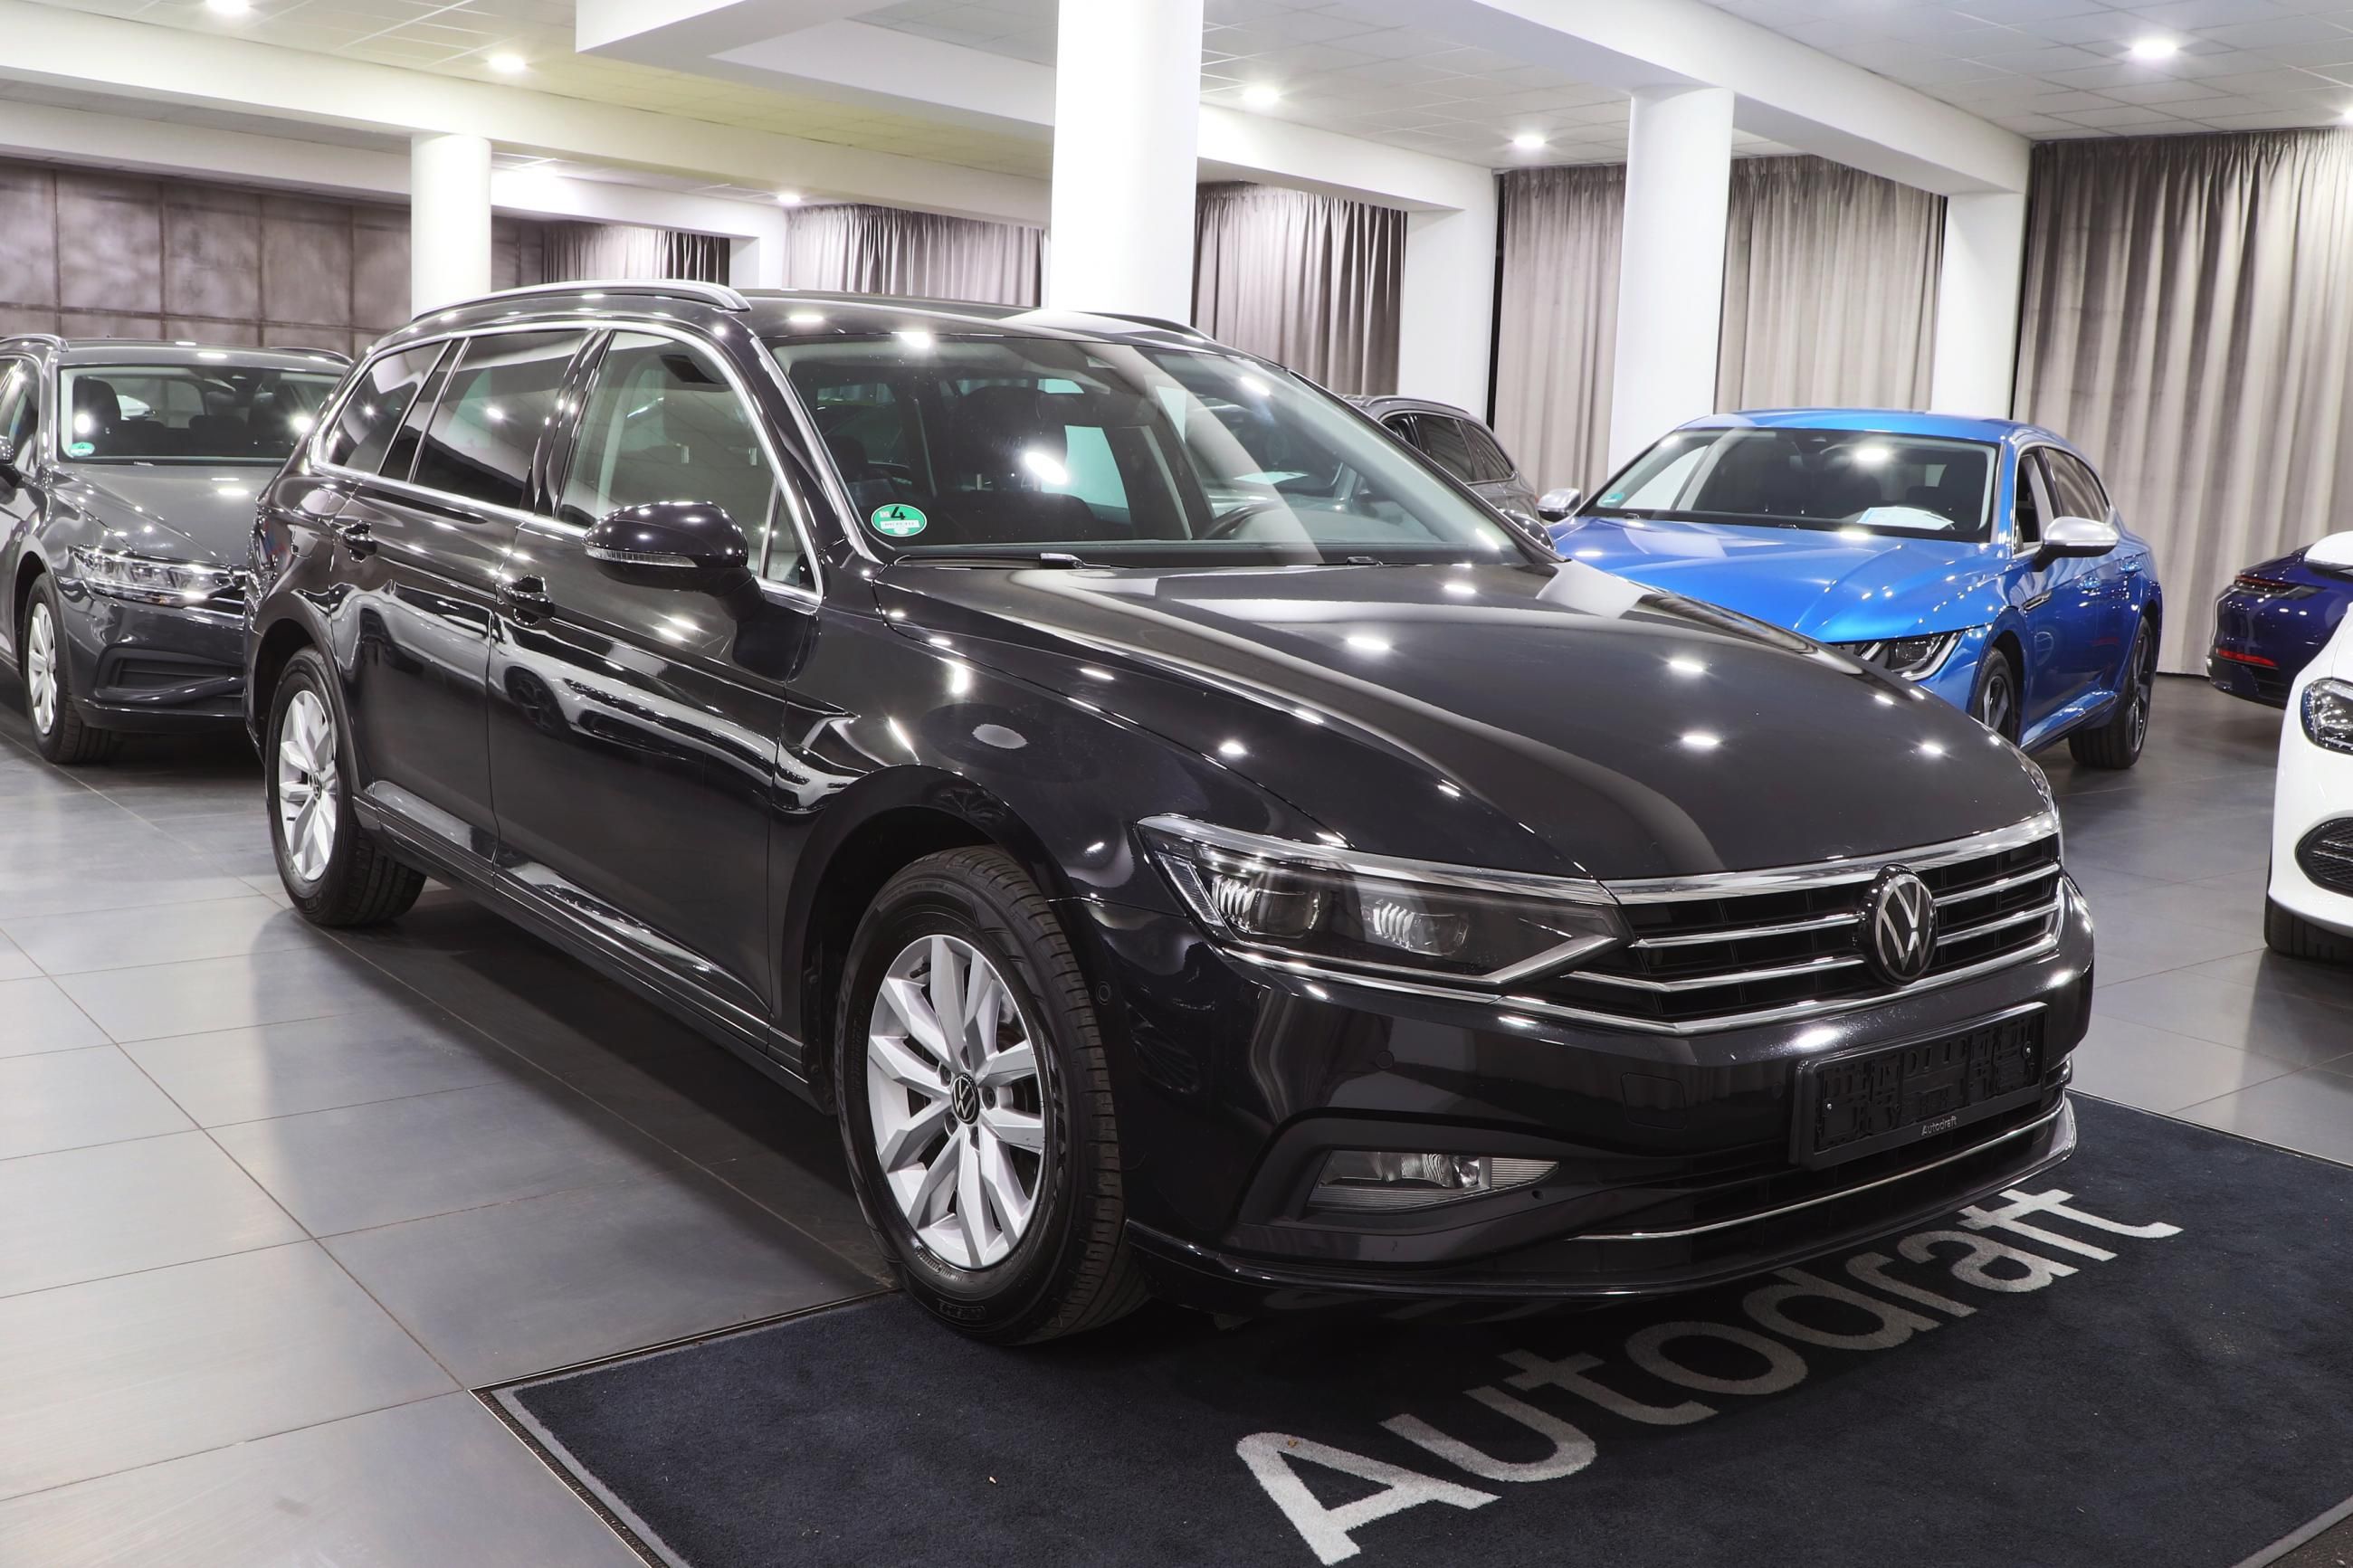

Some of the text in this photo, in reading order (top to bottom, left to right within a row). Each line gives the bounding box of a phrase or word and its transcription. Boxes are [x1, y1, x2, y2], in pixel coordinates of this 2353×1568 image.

[891, 507, 906, 520] 4
[1921, 1116, 1957, 1136] Autodraft
[1236, 1189, 2184, 1567] Autodraft
